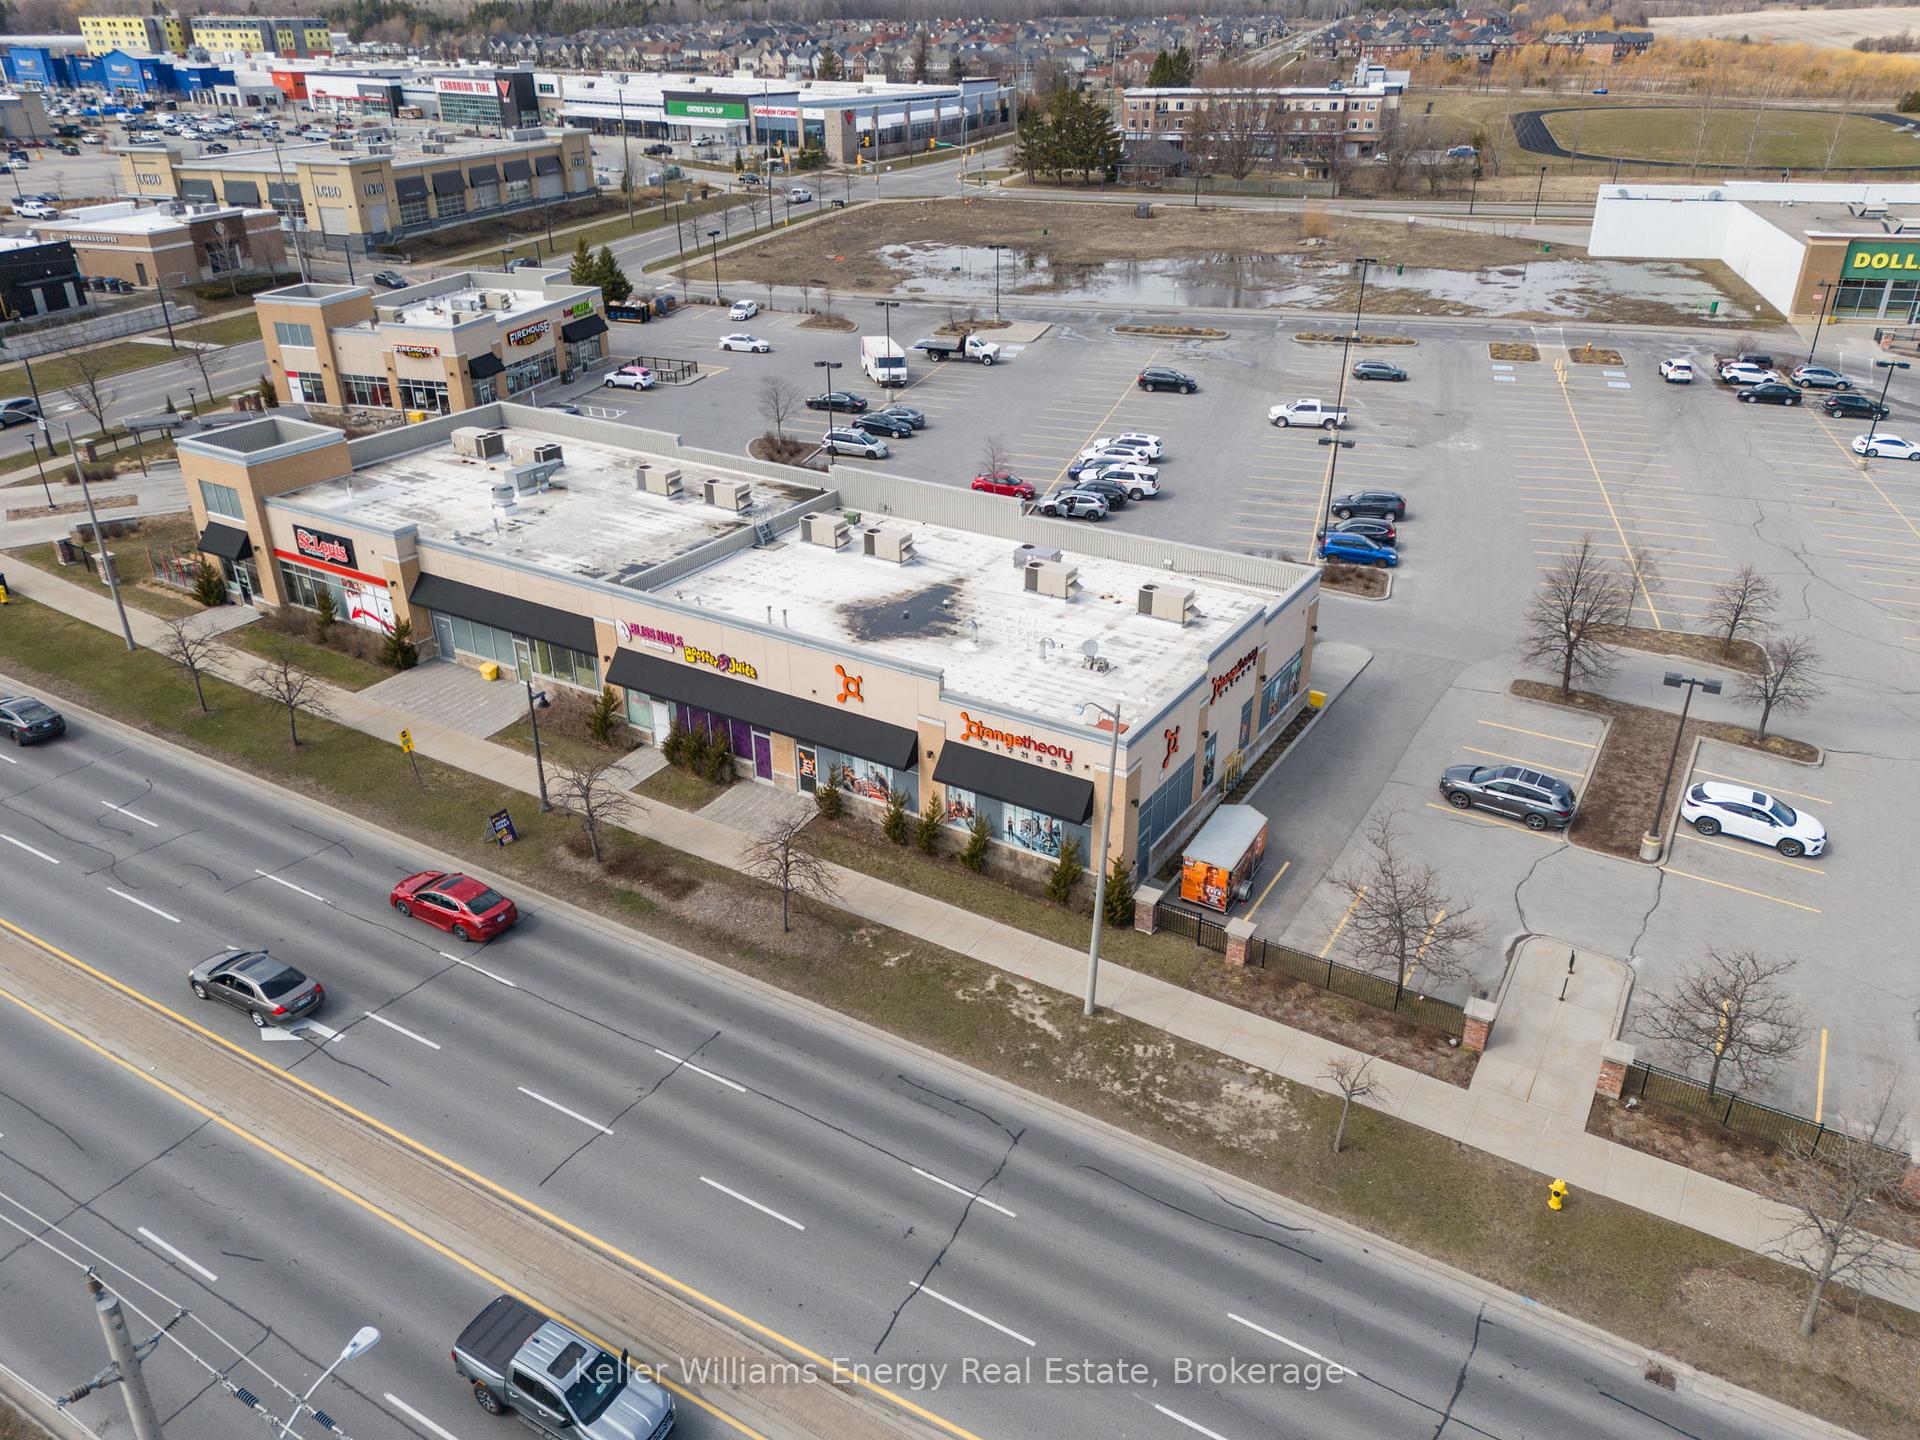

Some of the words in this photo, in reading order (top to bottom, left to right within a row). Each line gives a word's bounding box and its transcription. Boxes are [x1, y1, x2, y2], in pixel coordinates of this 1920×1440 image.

[440, 80, 474, 92] CANADIAN
[475, 82, 491, 93] TIRE
[754, 107, 776, 115] GARDEN
[316, 184, 341, 199] LCBO
[1853, 252, 1920, 270] DOLL
[509, 321, 550, 346] FIREHOUSE
[395, 345, 436, 356] FIREHOUSE
[630, 622, 656, 640] BLISS
[656, 629, 684, 648] NAILS
[684, 645, 718, 669] Booster
[728, 657, 758, 679] Juice
